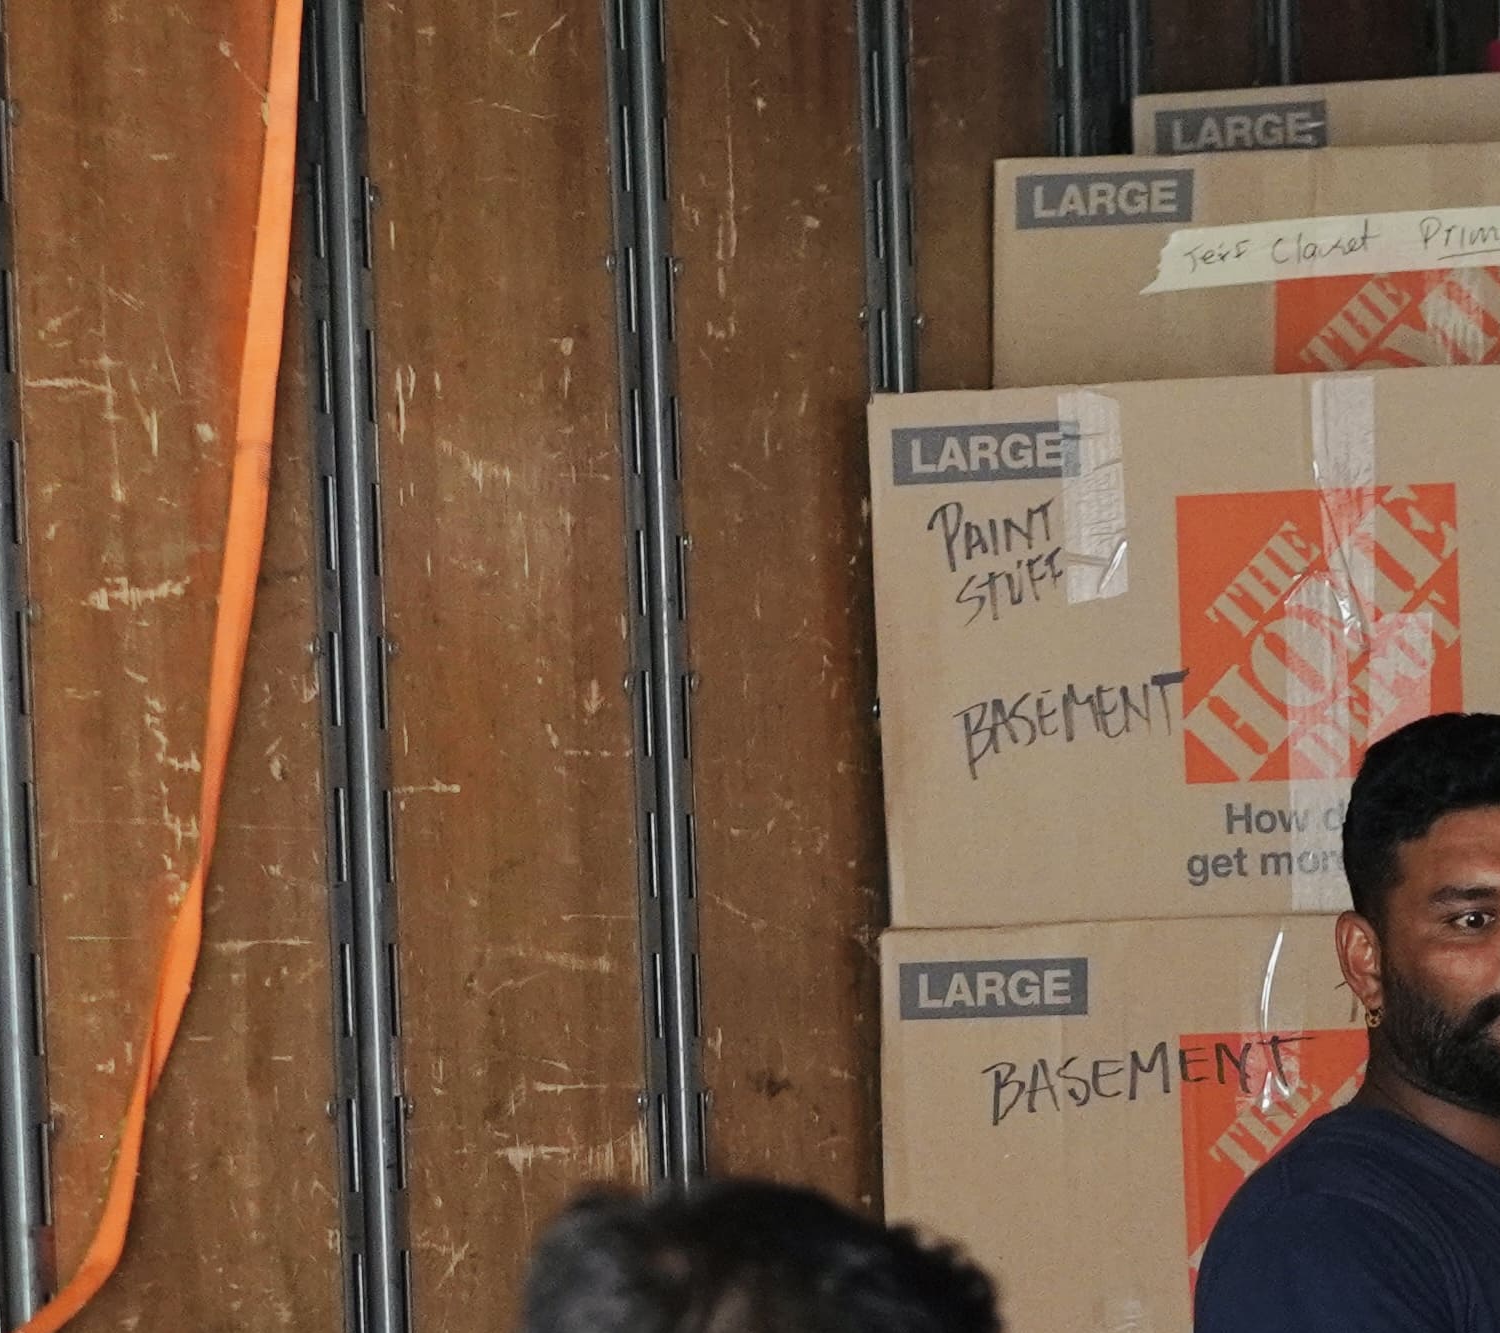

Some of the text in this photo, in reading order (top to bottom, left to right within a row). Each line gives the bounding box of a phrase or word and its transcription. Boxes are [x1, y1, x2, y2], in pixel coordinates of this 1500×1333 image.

[1172, 112, 1318, 150] LARGE
[1032, 178, 1178, 218] LARGE
[911, 430, 1064, 472] LARGE
[927, 499, 1055, 571] PAINT
[1203, 521, 1321, 638] THE
[1183, 486, 1458, 781] HOME
[955, 668, 1189, 779] BASEMENT
[1226, 803, 1309, 834] How
[1187, 847, 1248, 886] get
[917, 968, 1072, 1008] LARGE
[981, 1036, 1316, 1125] BASEMENT
